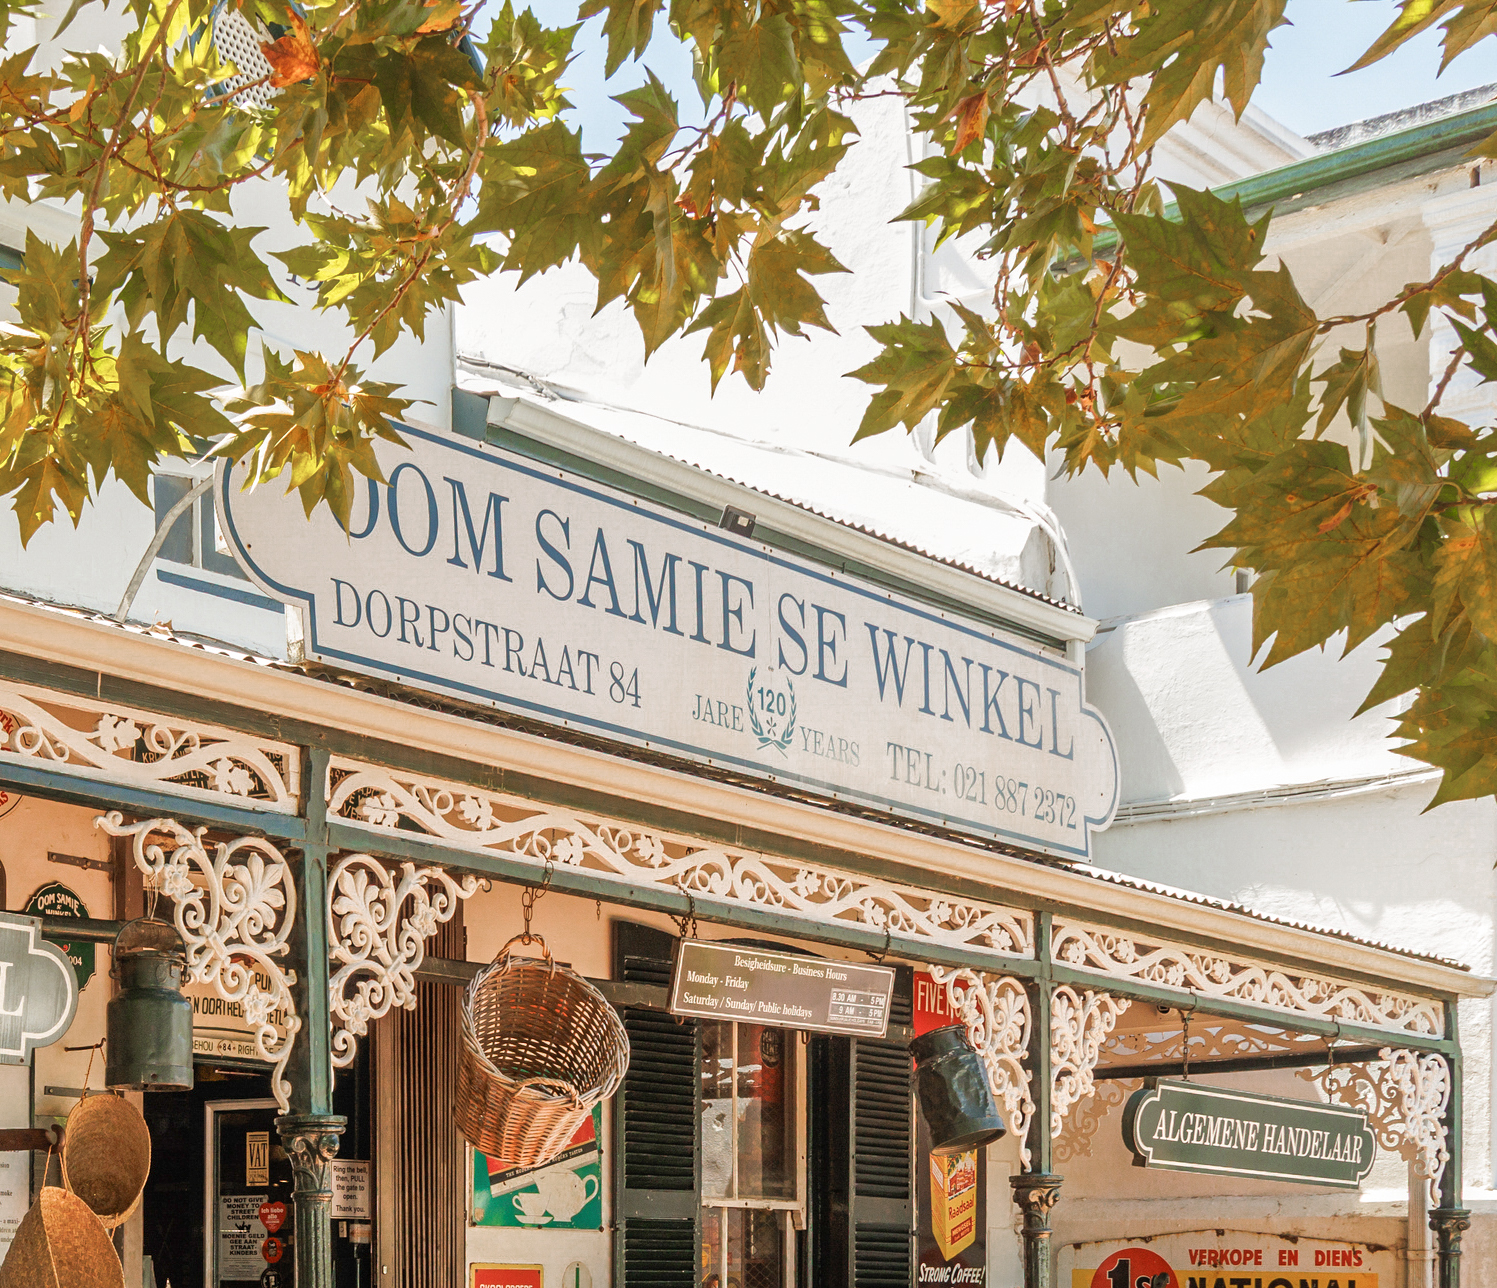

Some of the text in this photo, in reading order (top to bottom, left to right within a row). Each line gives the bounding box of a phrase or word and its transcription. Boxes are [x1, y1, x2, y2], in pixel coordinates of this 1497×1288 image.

[330, 577, 642, 708] DORPSTRAAT 84
[535, 508, 756, 659] SAMIE
[777, 592, 848, 688] SE
[864, 622, 1074, 761] WINKEL
[692, 687, 860, 767] JARE 120 YEARS
[887, 741, 1077, 830] TEL: 021 887 2372
[37, 891, 80, 917] OOM SAMIE
[687, 970, 749, 991] Monday Friday
[734, 955, 847, 981] Besigheidsure Business Hours
[683, 992, 719, 1008] Saturday
[758, 1002, 781, 1014] Public
[782, 1003, 812, 1018] holidays
[832, 992, 845, 1002] 8.30
[846, 994, 857, 1002] AM
[870, 996, 875, 1005] 5
[918, 980, 944, 1015] FIVE
[845, 1006, 855, 1014] AM
[869, 1009, 873, 1017] 5
[222, 1043, 231, 1051] 84
[1152, 1108, 1364, 1164] ALGEMENE HANDELAAR
[249, 1143, 267, 1167] VAT
[333, 1165, 346, 1174] Ring
[346, 1184, 357, 1193] gate
[336, 1204, 352, 1212] Thank
[948, 1194, 974, 1221] Raadsaal
[1188, 1249, 1363, 1267] VERKOPE EN DIENS
[919, 1263, 985, 1285] STRONG COFFEE!
